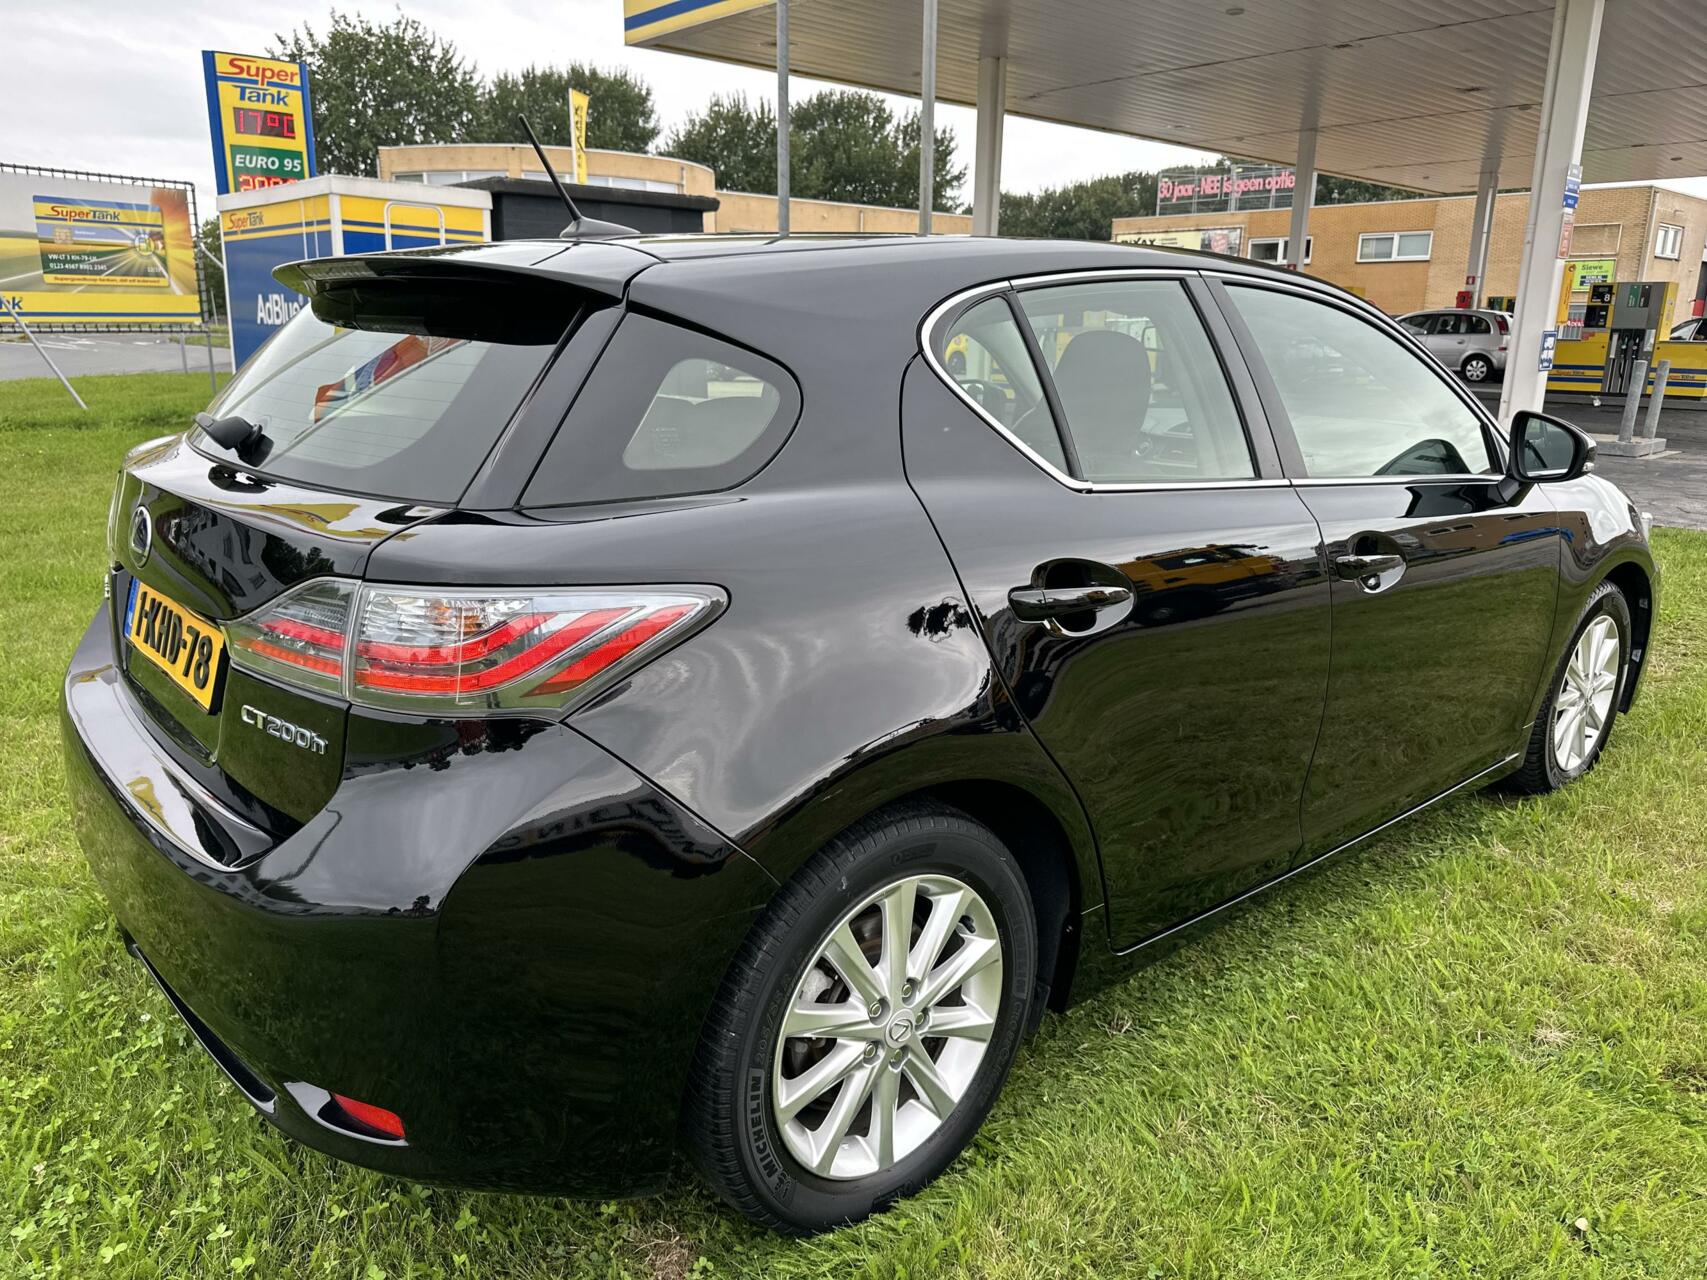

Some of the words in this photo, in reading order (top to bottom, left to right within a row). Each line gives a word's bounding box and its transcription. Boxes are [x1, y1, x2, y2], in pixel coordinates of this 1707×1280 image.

[217, 57, 299, 87] Super
[231, 85, 289, 107] Tank
[235, 154, 279, 170] EURO
[283, 156, 301, 172] 95
[1172, 181, 1195, 202] jaar
[1200, 175, 1221, 195] NEE
[1223, 175, 1232, 193] is
[1233, 178, 1264, 198] geen
[1265, 171, 1296, 194] optie
[45, 205, 120, 223] SuperTank
[227, 211, 264, 233] SuperTank
[257, 293, 300, 325] AdBlue
[1604, 294, 1610, 302] 8
[135, 590, 213, 690] 1-KHD-78
[240, 704, 328, 755] CT200h
[750, 1075, 778, 1179] MICHELIN
